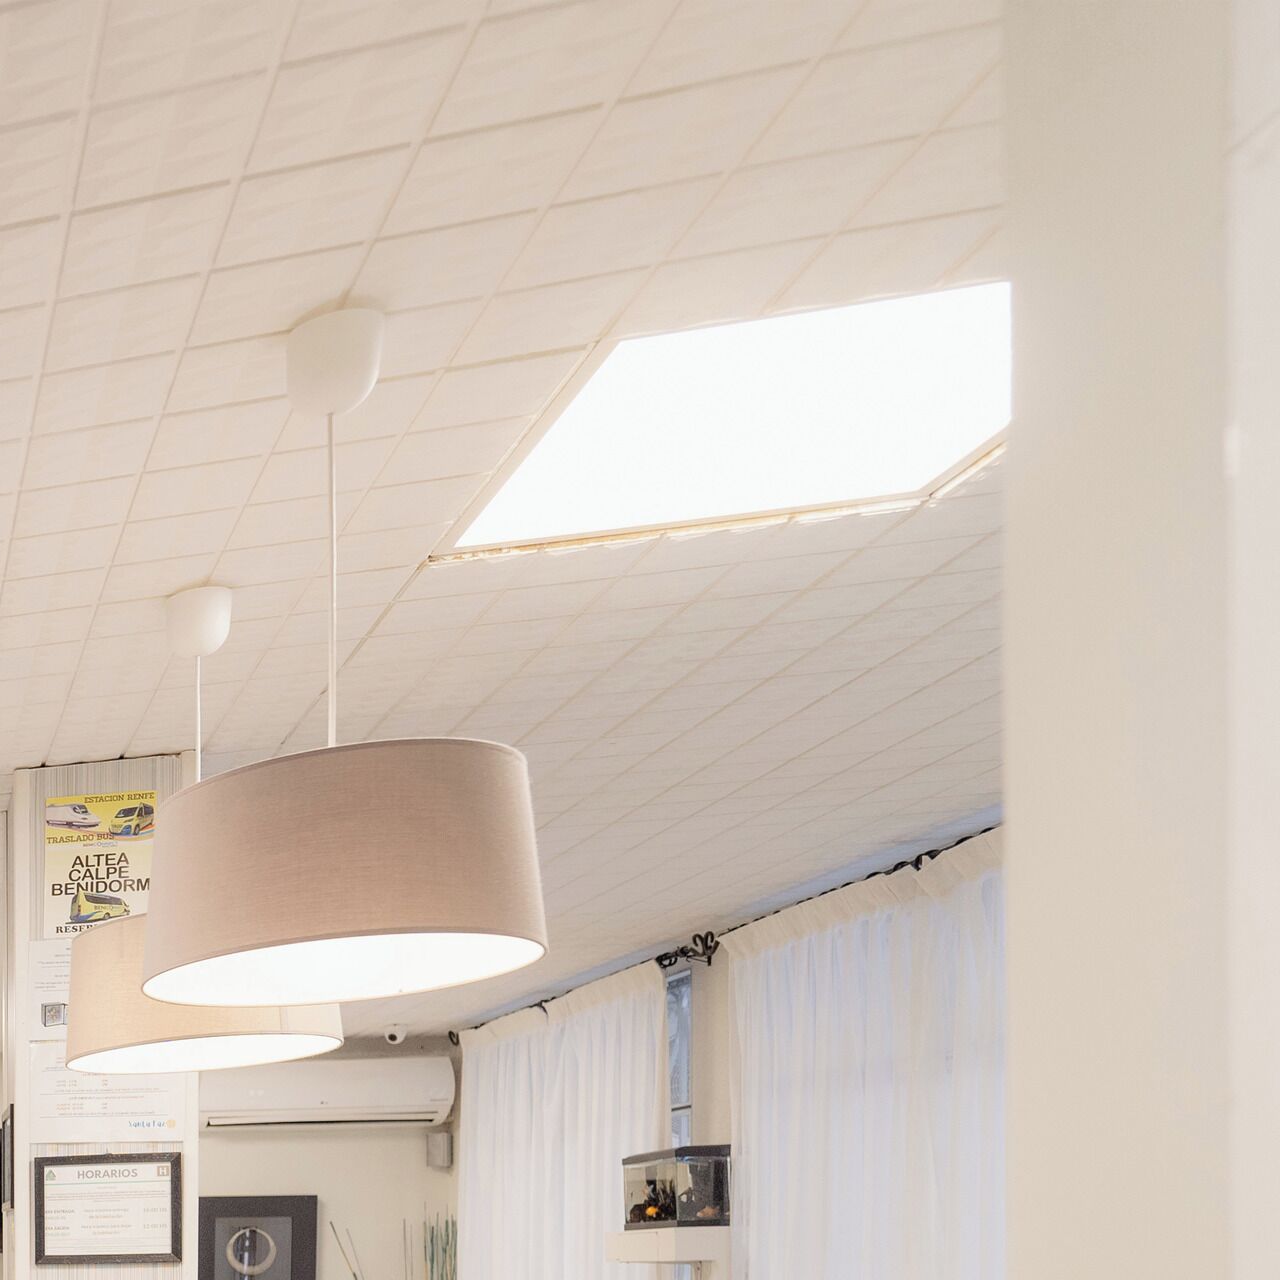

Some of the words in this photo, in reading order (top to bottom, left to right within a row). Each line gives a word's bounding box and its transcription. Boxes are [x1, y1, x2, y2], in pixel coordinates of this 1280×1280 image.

[84, 795, 124, 803] ESTACION
[127, 792, 155, 800] RENFE
[47, 834, 94, 844] TRASLADO
[72, 852, 129, 868] ALTEA
[68, 866, 129, 882] CALPE
[52, 878, 150, 896] BENIDORM
[77, 1168, 138, 1179] HORARIOS
